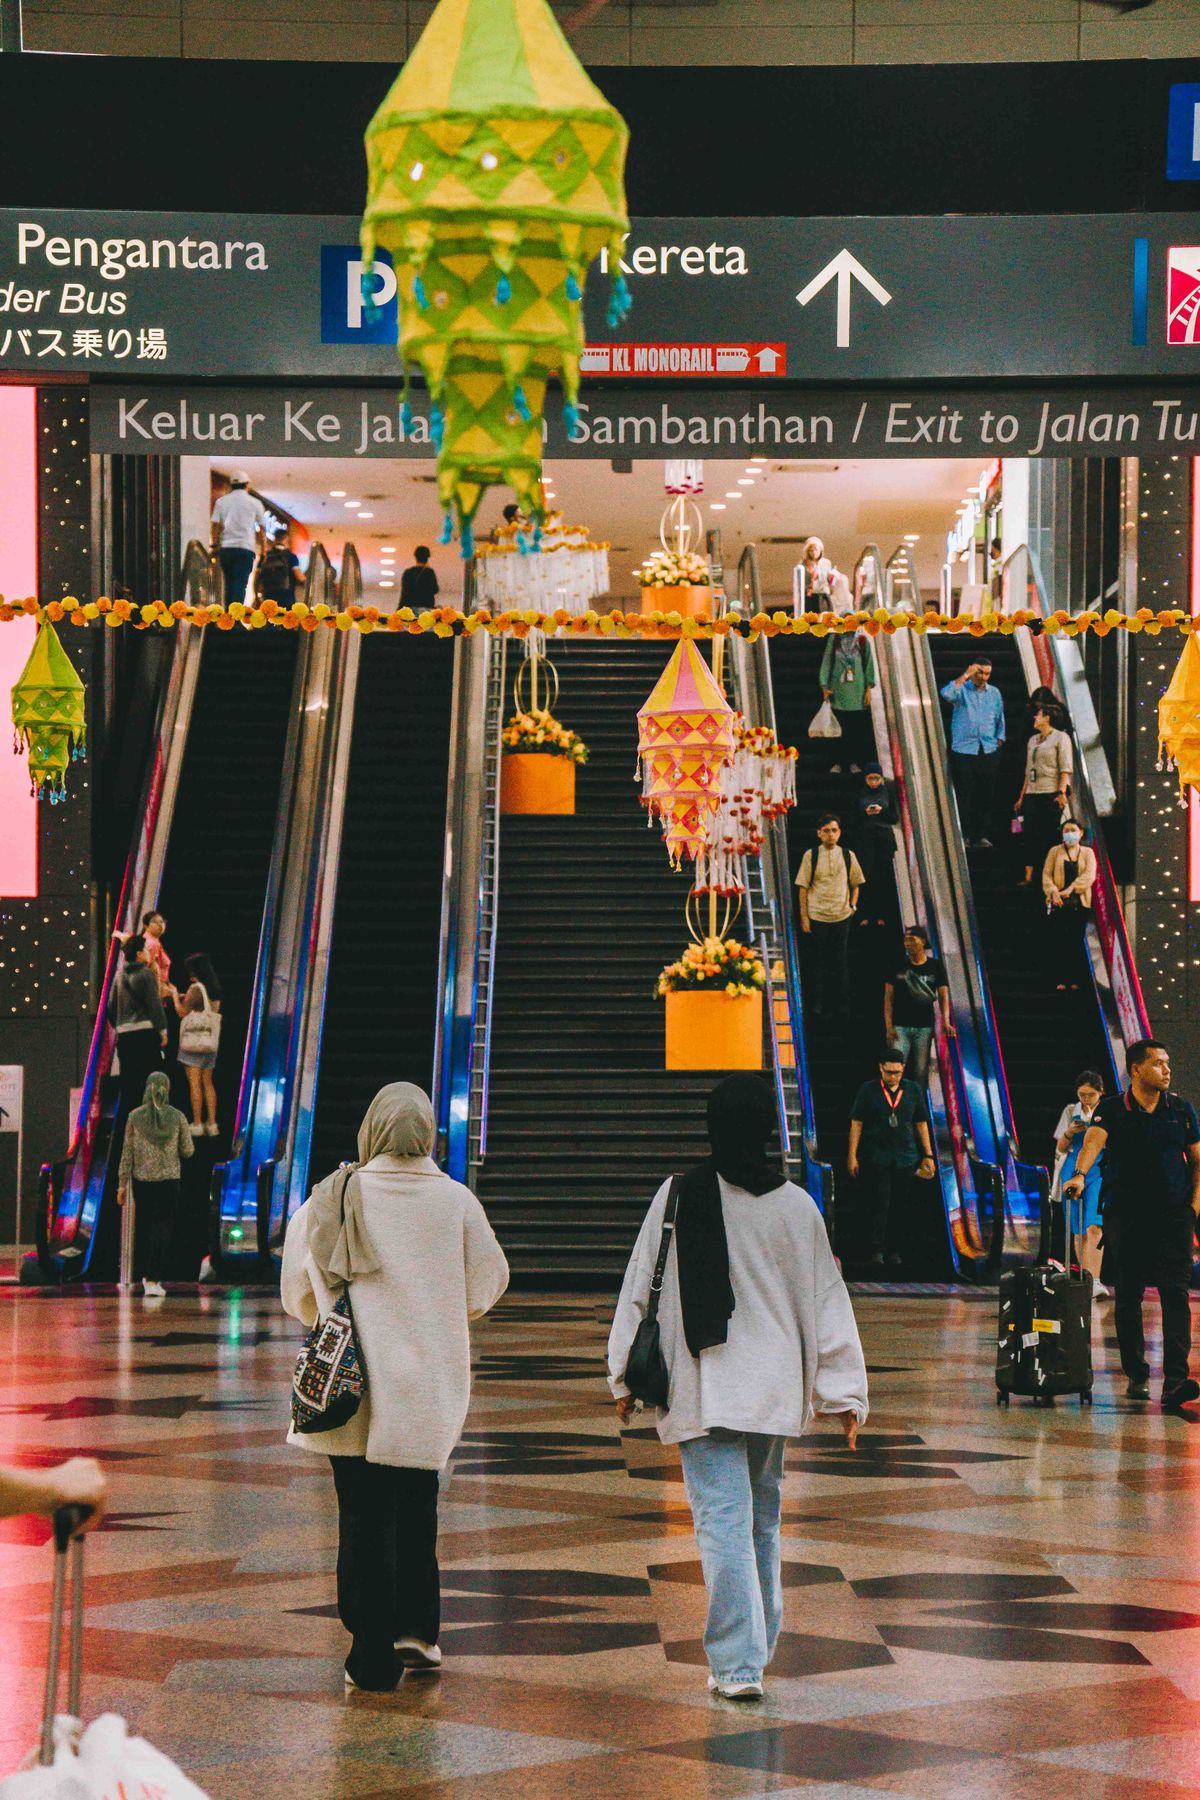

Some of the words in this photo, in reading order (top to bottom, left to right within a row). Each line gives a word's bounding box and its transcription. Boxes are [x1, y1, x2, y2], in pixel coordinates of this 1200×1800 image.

[17, 222, 269, 280] Pengantara
[58, 283, 128, 315] Bus
[346, 260, 398, 329] P
[0, 327, 168, 360] バス乗り場
[612, 348, 631, 371] KL
[634, 347, 715, 372] MONORAIL
[118, 398, 266, 442] Keluar
[284, 401, 341, 443] Ke
[354, 401, 446, 455] Jala
[568, 402, 834, 444] Sambanthan
[851, 402, 867, 444] /
[884, 403, 964, 444] Exit
[979, 410, 1019, 443] to
[1027, 401, 1140, 456] Jalan
[1152, 400, 1198, 442] Tu
